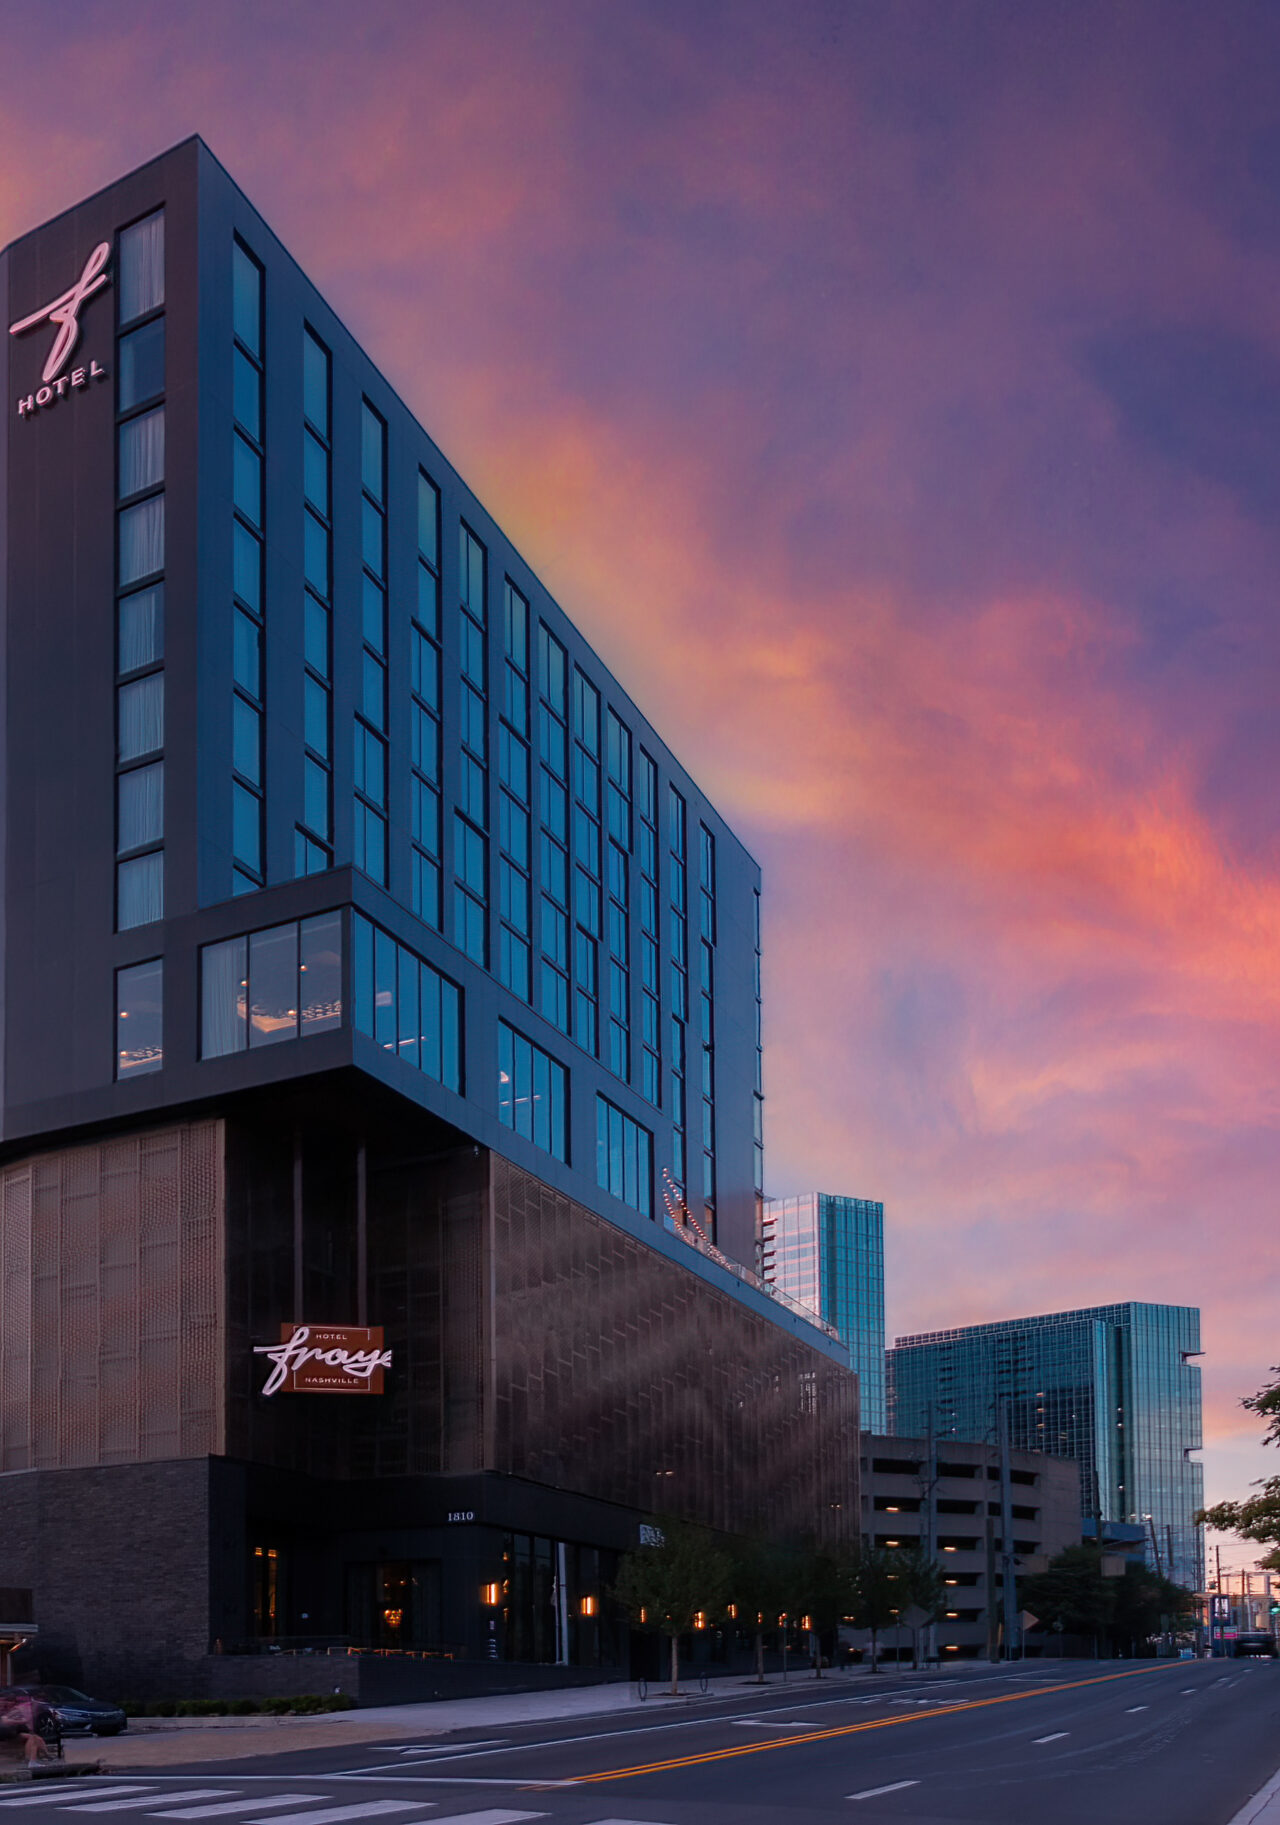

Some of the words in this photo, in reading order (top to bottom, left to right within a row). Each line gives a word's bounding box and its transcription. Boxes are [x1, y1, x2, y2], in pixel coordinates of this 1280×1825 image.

[18, 360, 105, 415] HOTEL
[315, 1333, 348, 1341] HOTEL
[305, 1376, 359, 1385] NASHVILLE
[447, 1511, 474, 1522] 1810
